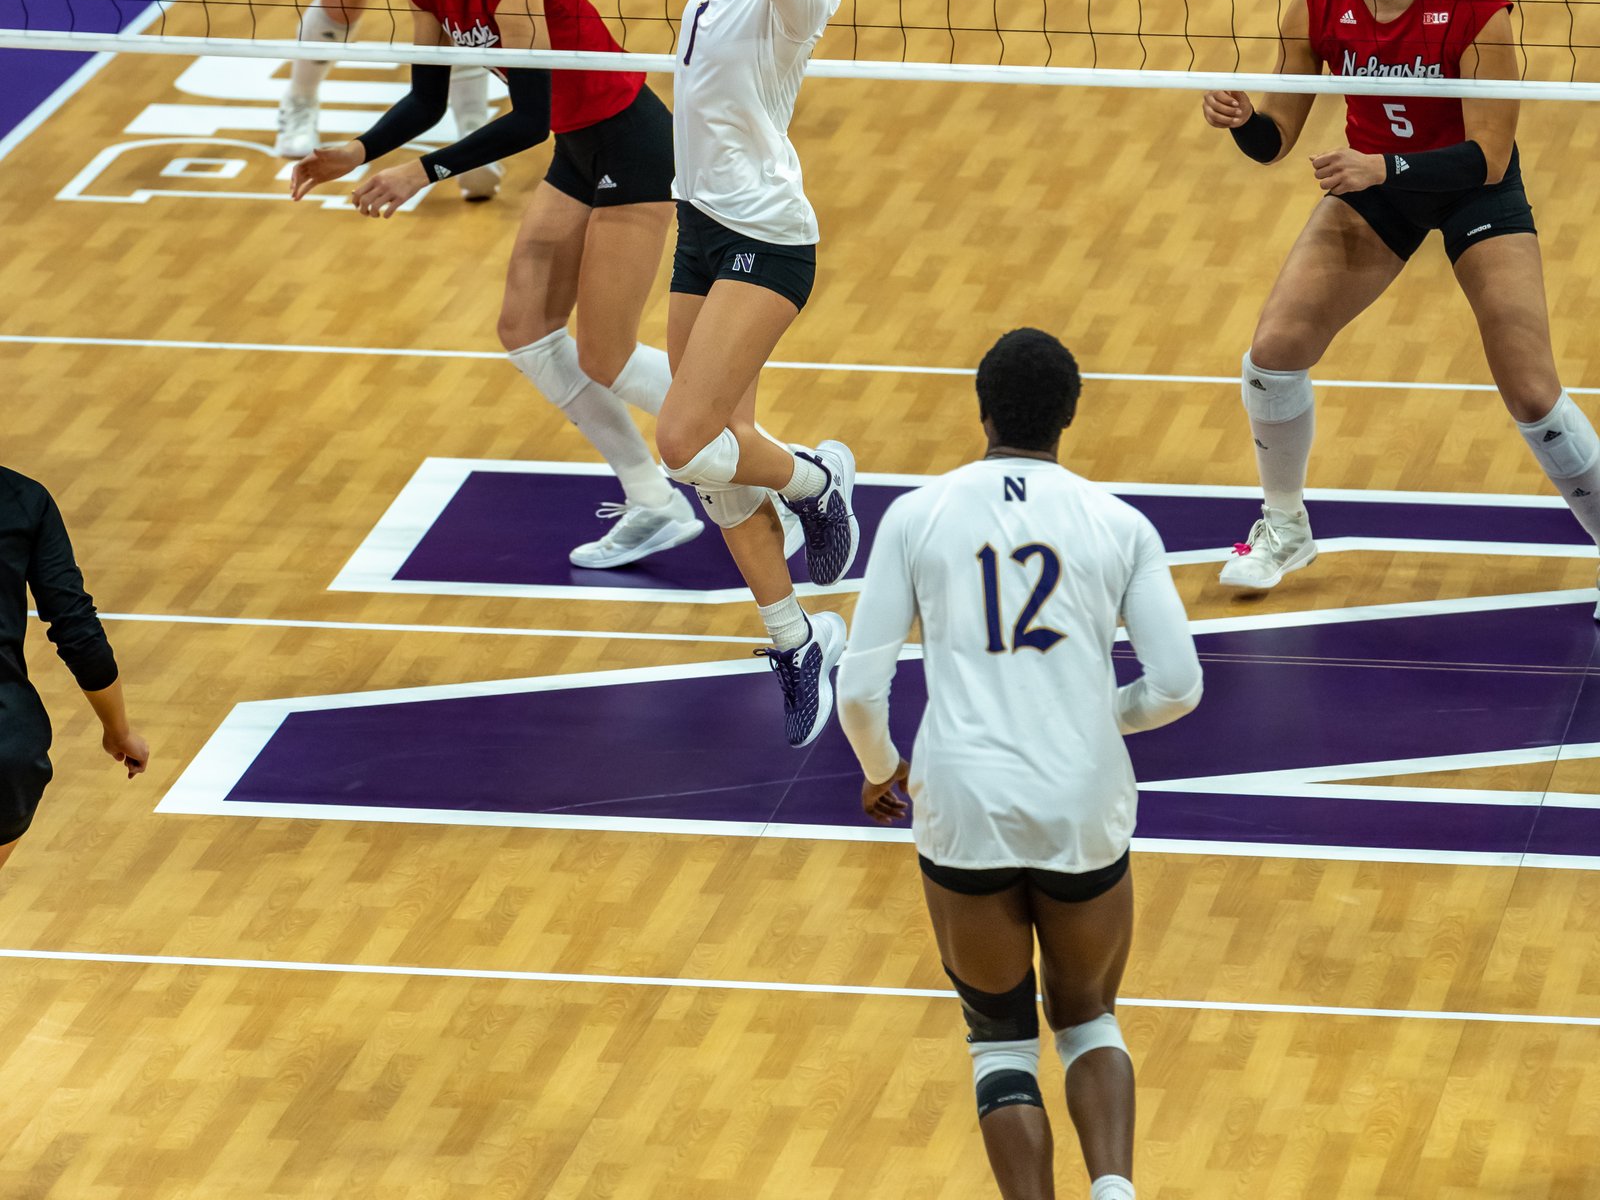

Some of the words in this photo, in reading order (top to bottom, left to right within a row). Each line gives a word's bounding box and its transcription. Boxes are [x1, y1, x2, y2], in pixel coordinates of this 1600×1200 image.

[683, 0, 710, 66] 1
[1342, 49, 1444, 79] Nebraska
[1382, 103, 1414, 138] 5
[732, 253, 755, 273] N
[1003, 476, 1026, 502] N
[976, 542, 1069, 655] 12
